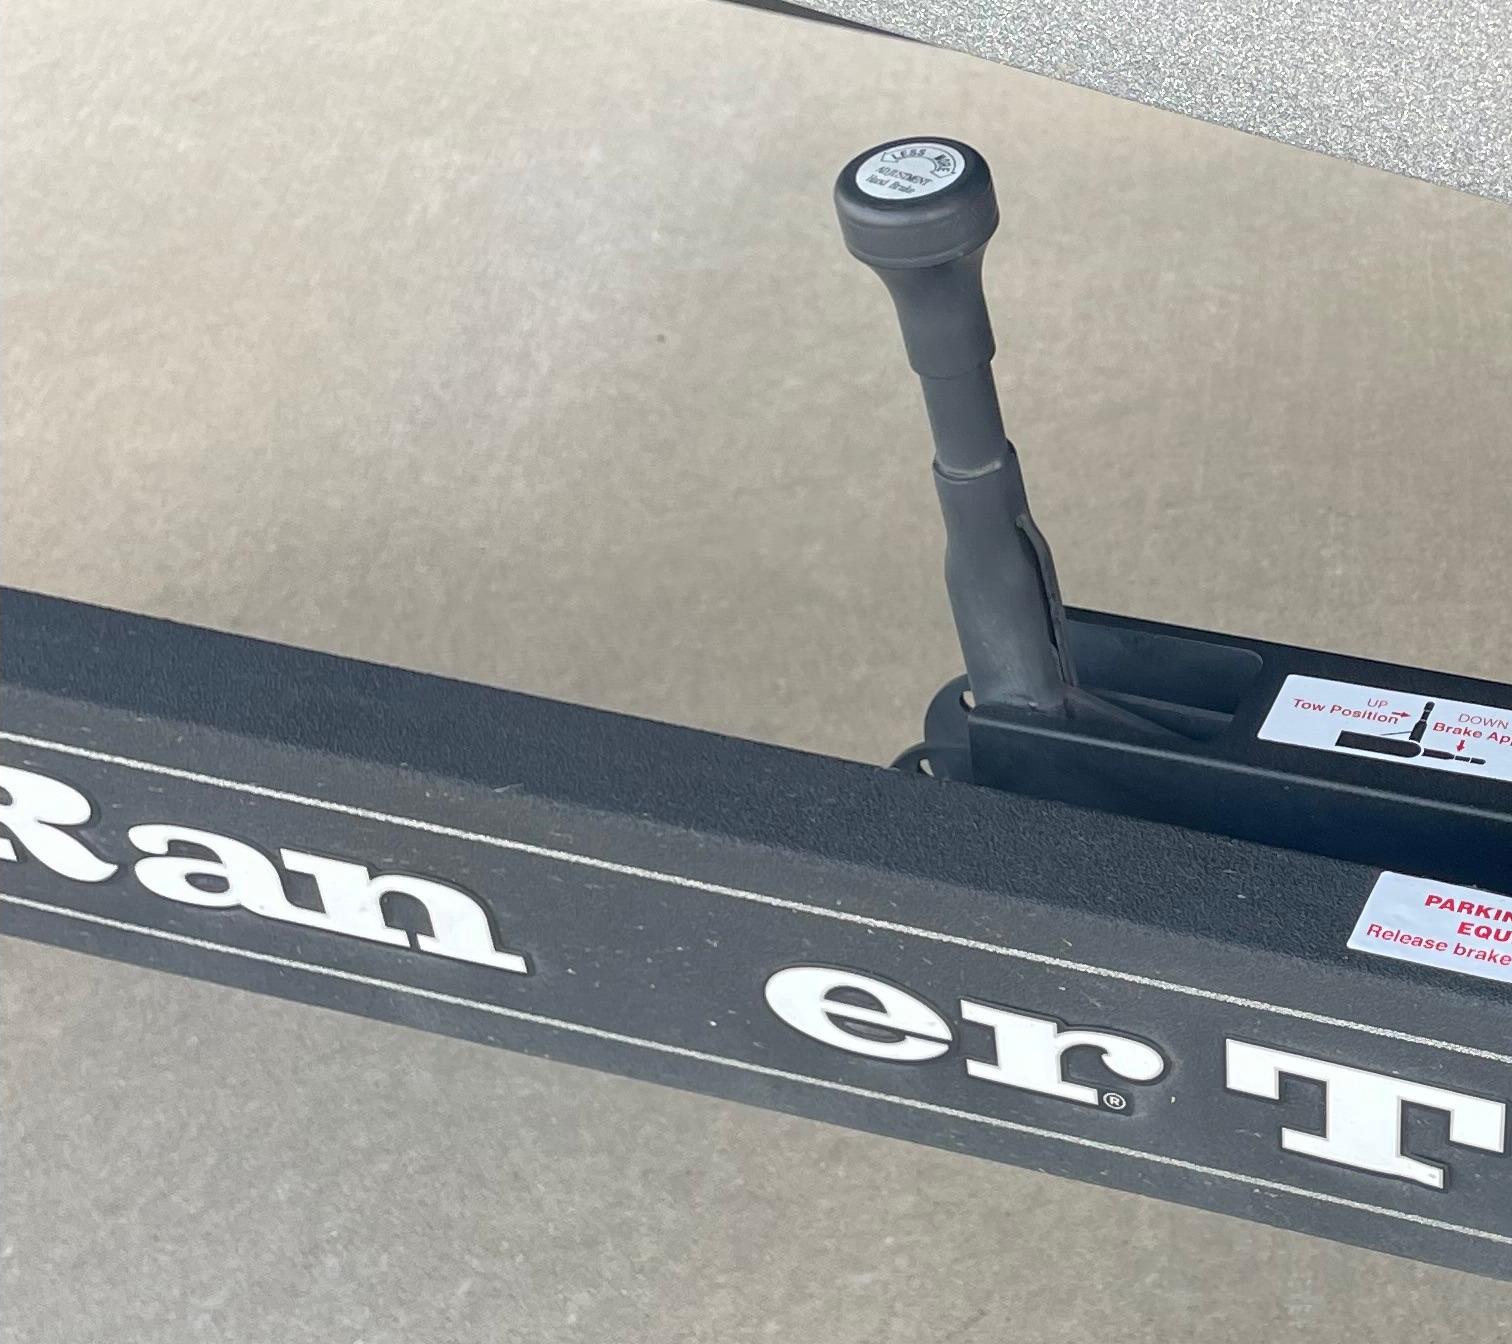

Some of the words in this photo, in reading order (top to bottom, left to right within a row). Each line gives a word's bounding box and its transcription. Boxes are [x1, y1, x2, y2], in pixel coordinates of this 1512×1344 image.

[891, 148, 926, 160] LESS
[876, 166, 933, 186] ADJUSTMENT
[1294, 698, 1326, 713] Tow
[1329, 704, 1399, 725] Position
[1367, 698, 1388, 709] UP
[1458, 713, 1509, 730] DOWN
[1432, 722, 1483, 739] Brake
[1366, 923, 1449, 952] Release
[1453, 942, 1512, 967] brake
